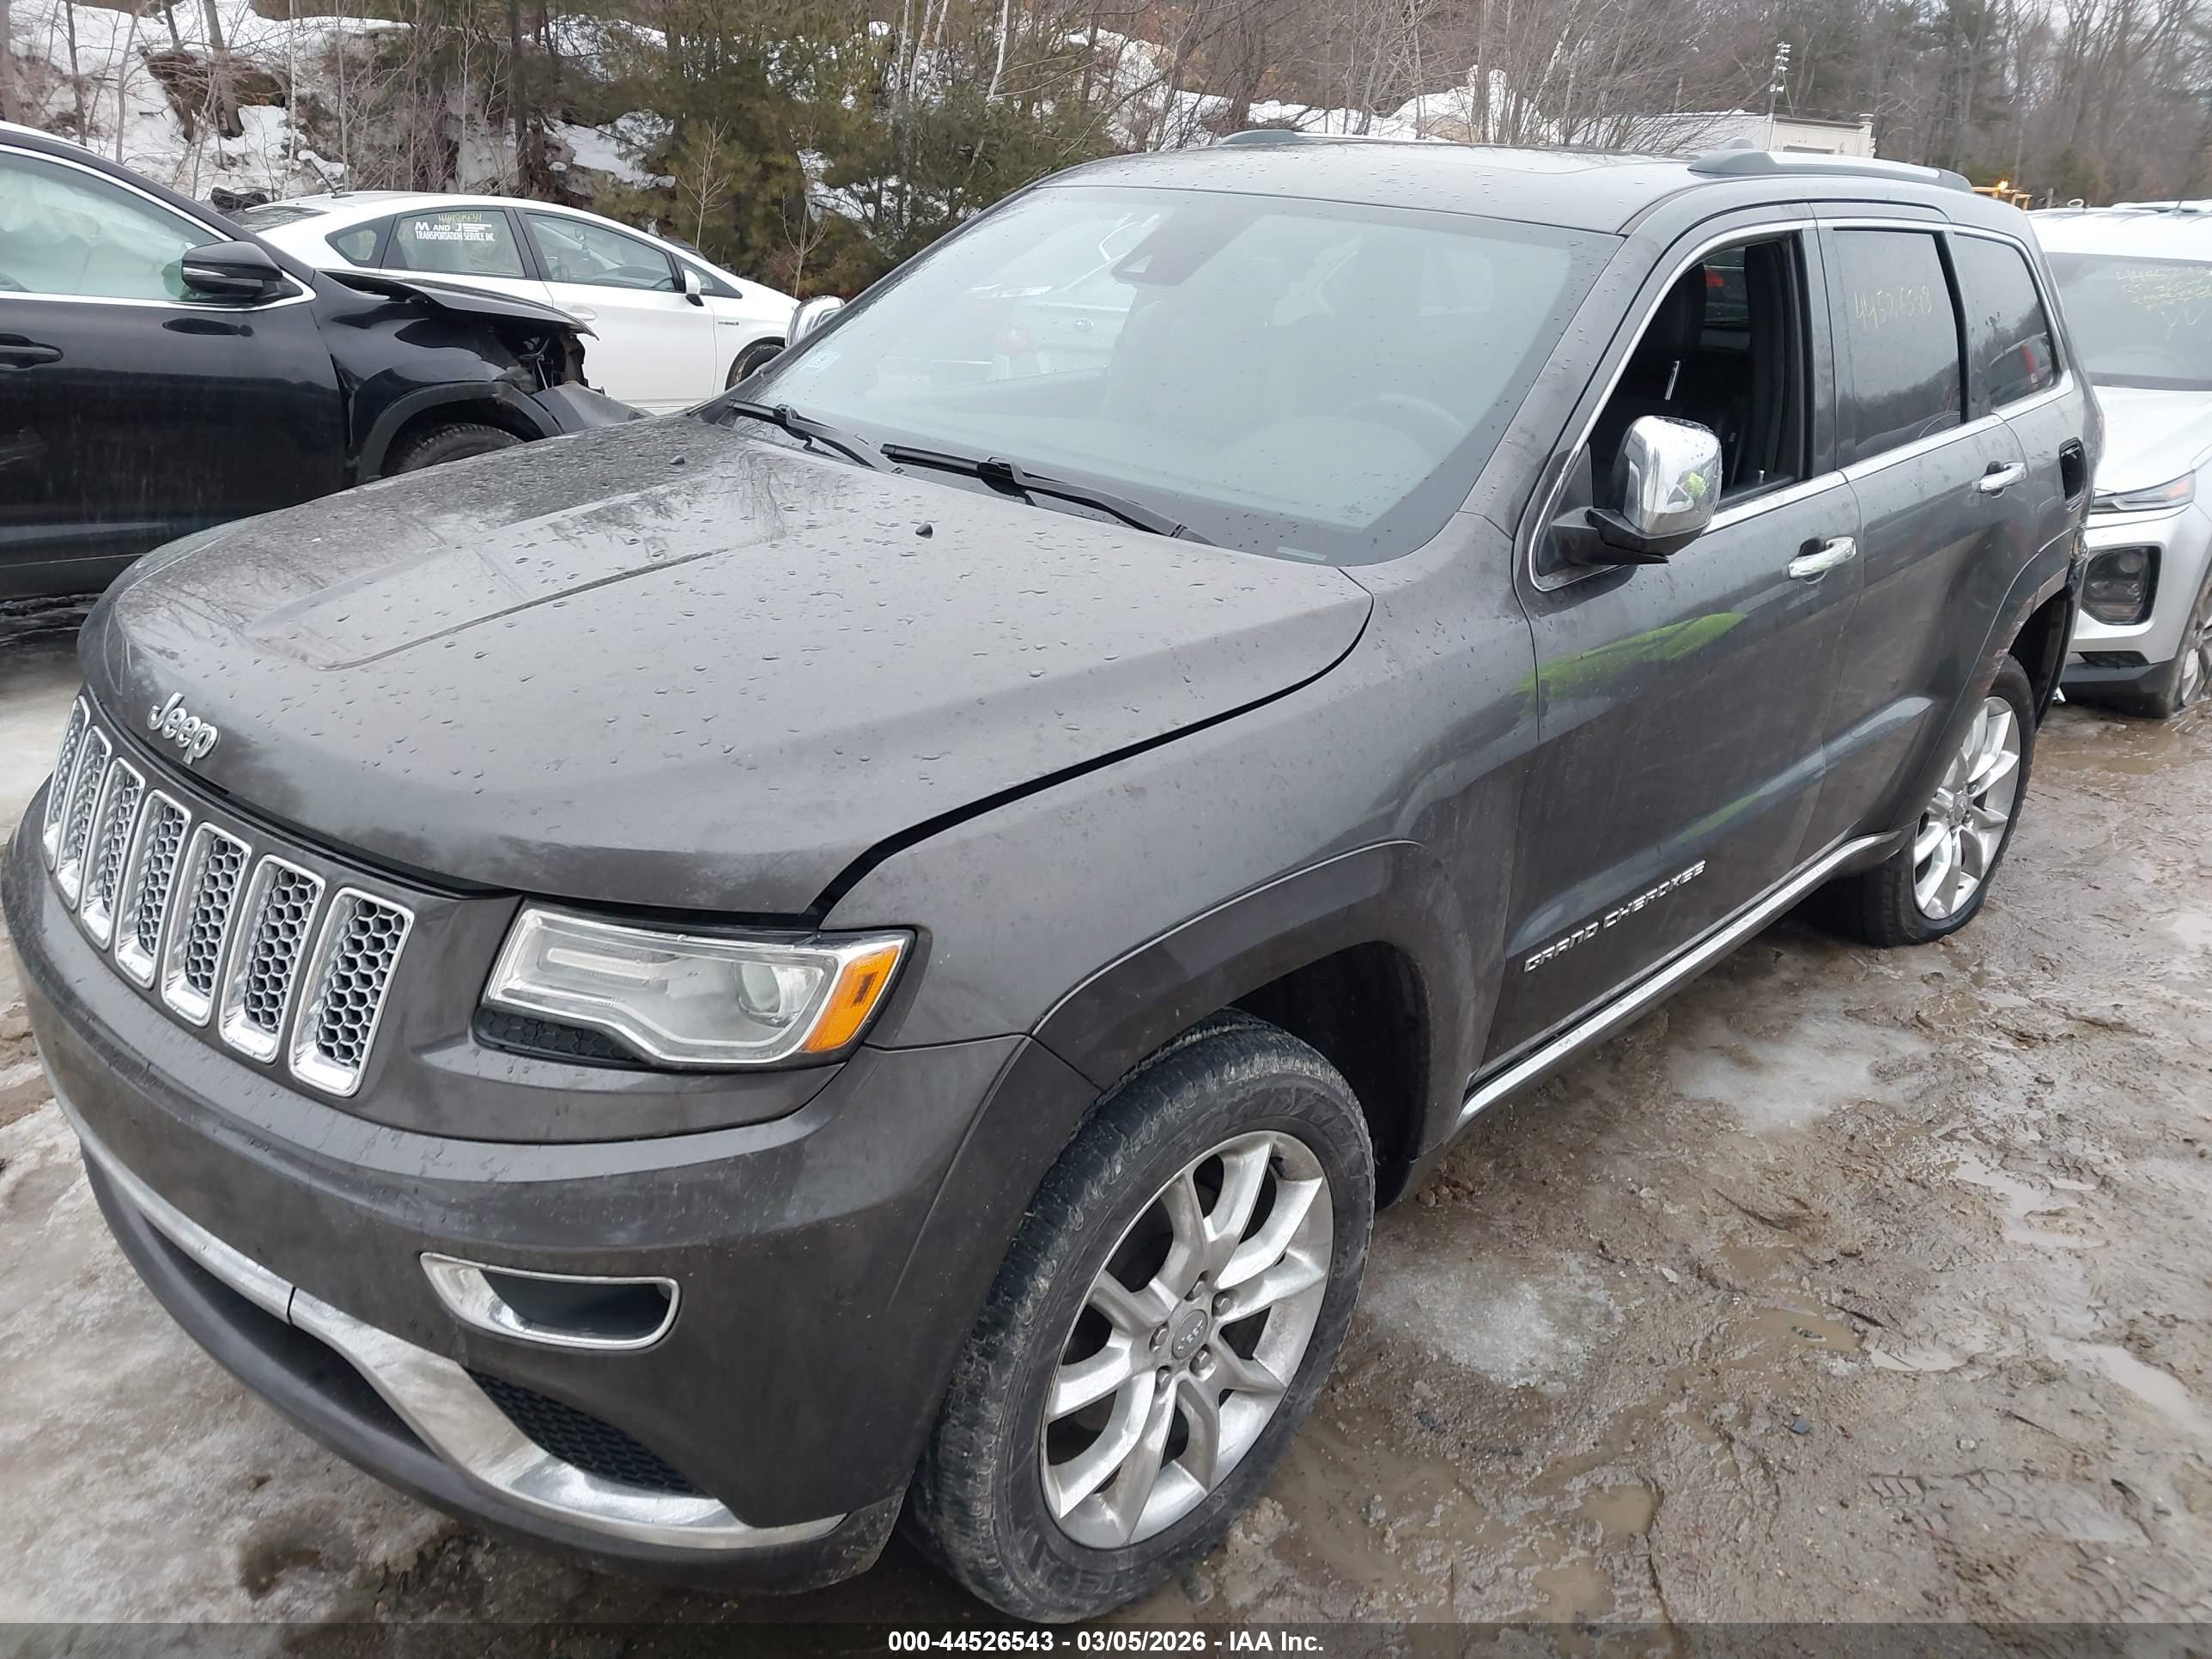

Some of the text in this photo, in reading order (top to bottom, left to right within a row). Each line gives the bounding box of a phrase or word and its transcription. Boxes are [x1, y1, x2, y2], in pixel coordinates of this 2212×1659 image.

[415, 222, 430, 231] M
[416, 230, 463, 240] TRANSPORTATION
[463, 232, 484, 241] SERVICE
[146, 690, 218, 765] Jeep
[1522, 859, 1707, 974] GRAND CHEROKEE
